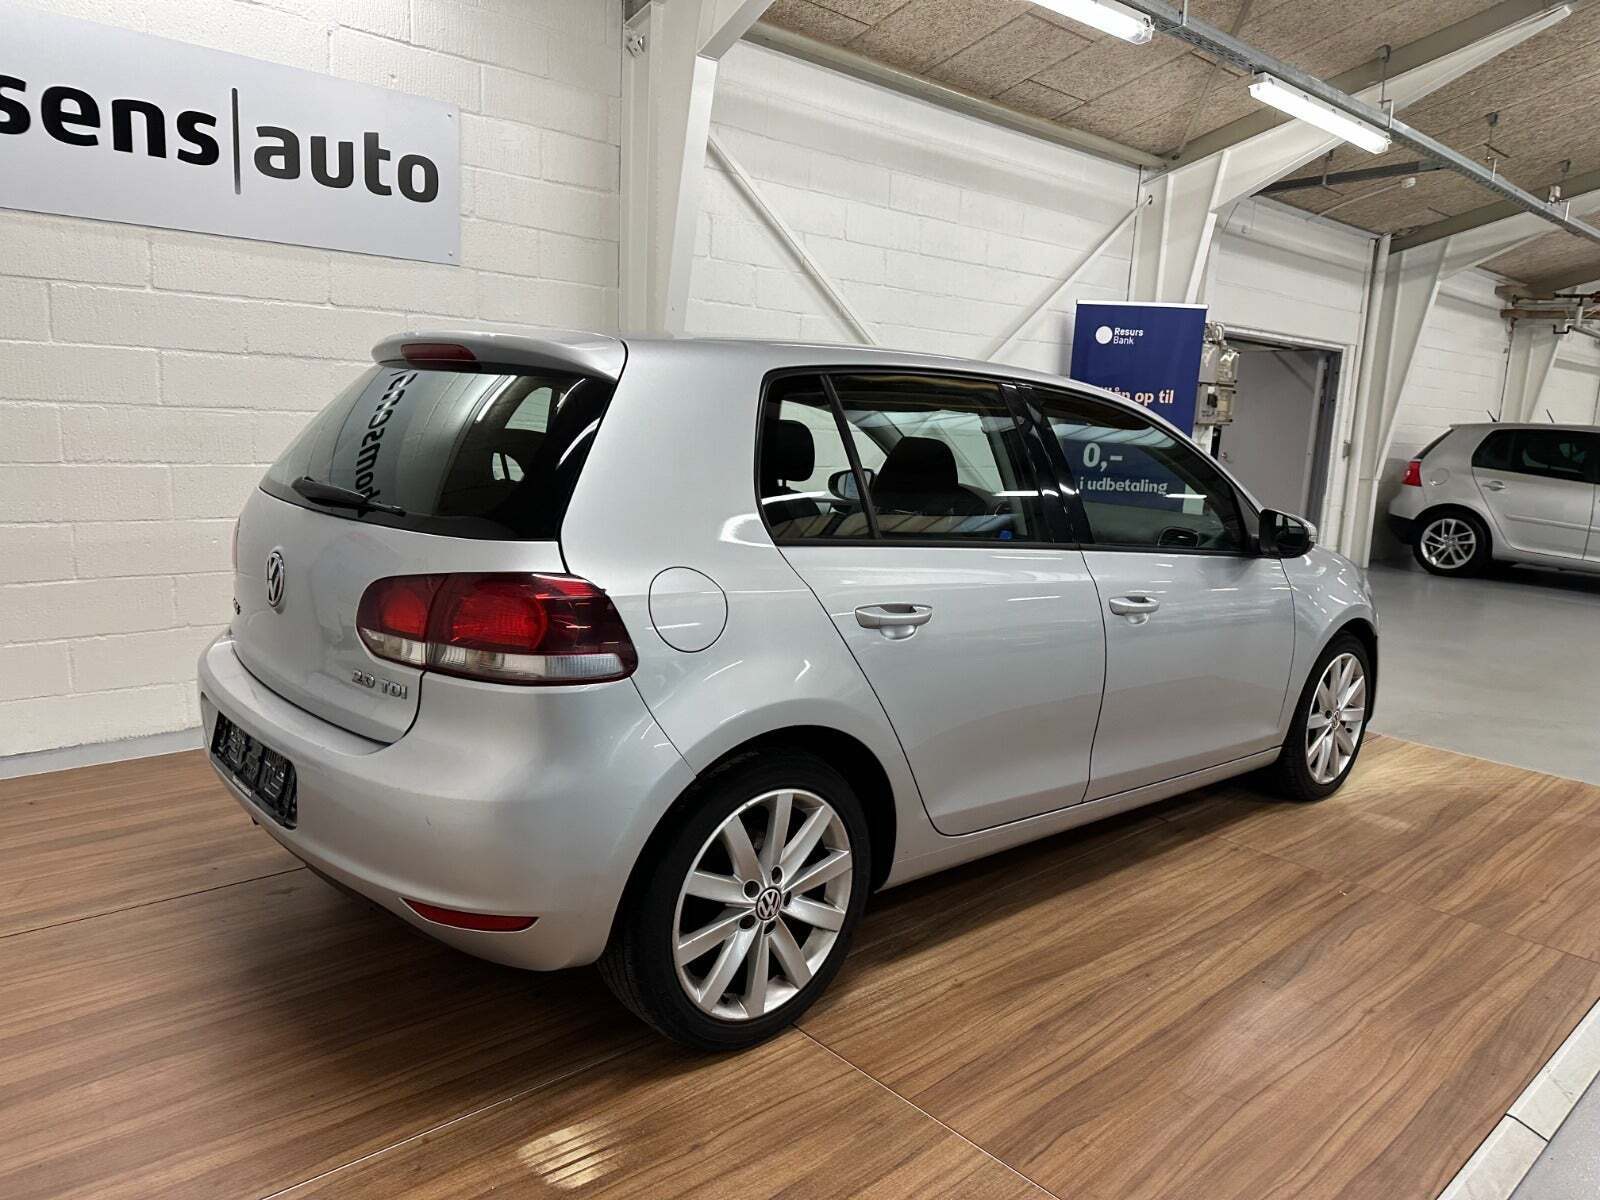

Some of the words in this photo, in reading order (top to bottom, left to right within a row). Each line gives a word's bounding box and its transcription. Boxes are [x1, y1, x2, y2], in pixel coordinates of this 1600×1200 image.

[253, 126, 439, 203] auto
[1113, 336, 1134, 345] Bank
[1114, 327, 1144, 337] Resurs
[1135, 391, 1155, 406] op
[1158, 389, 1175, 404] til
[1079, 477, 1084, 489] i
[1088, 478, 1168, 495] udbetaling
[382, 679, 408, 700] TDI
